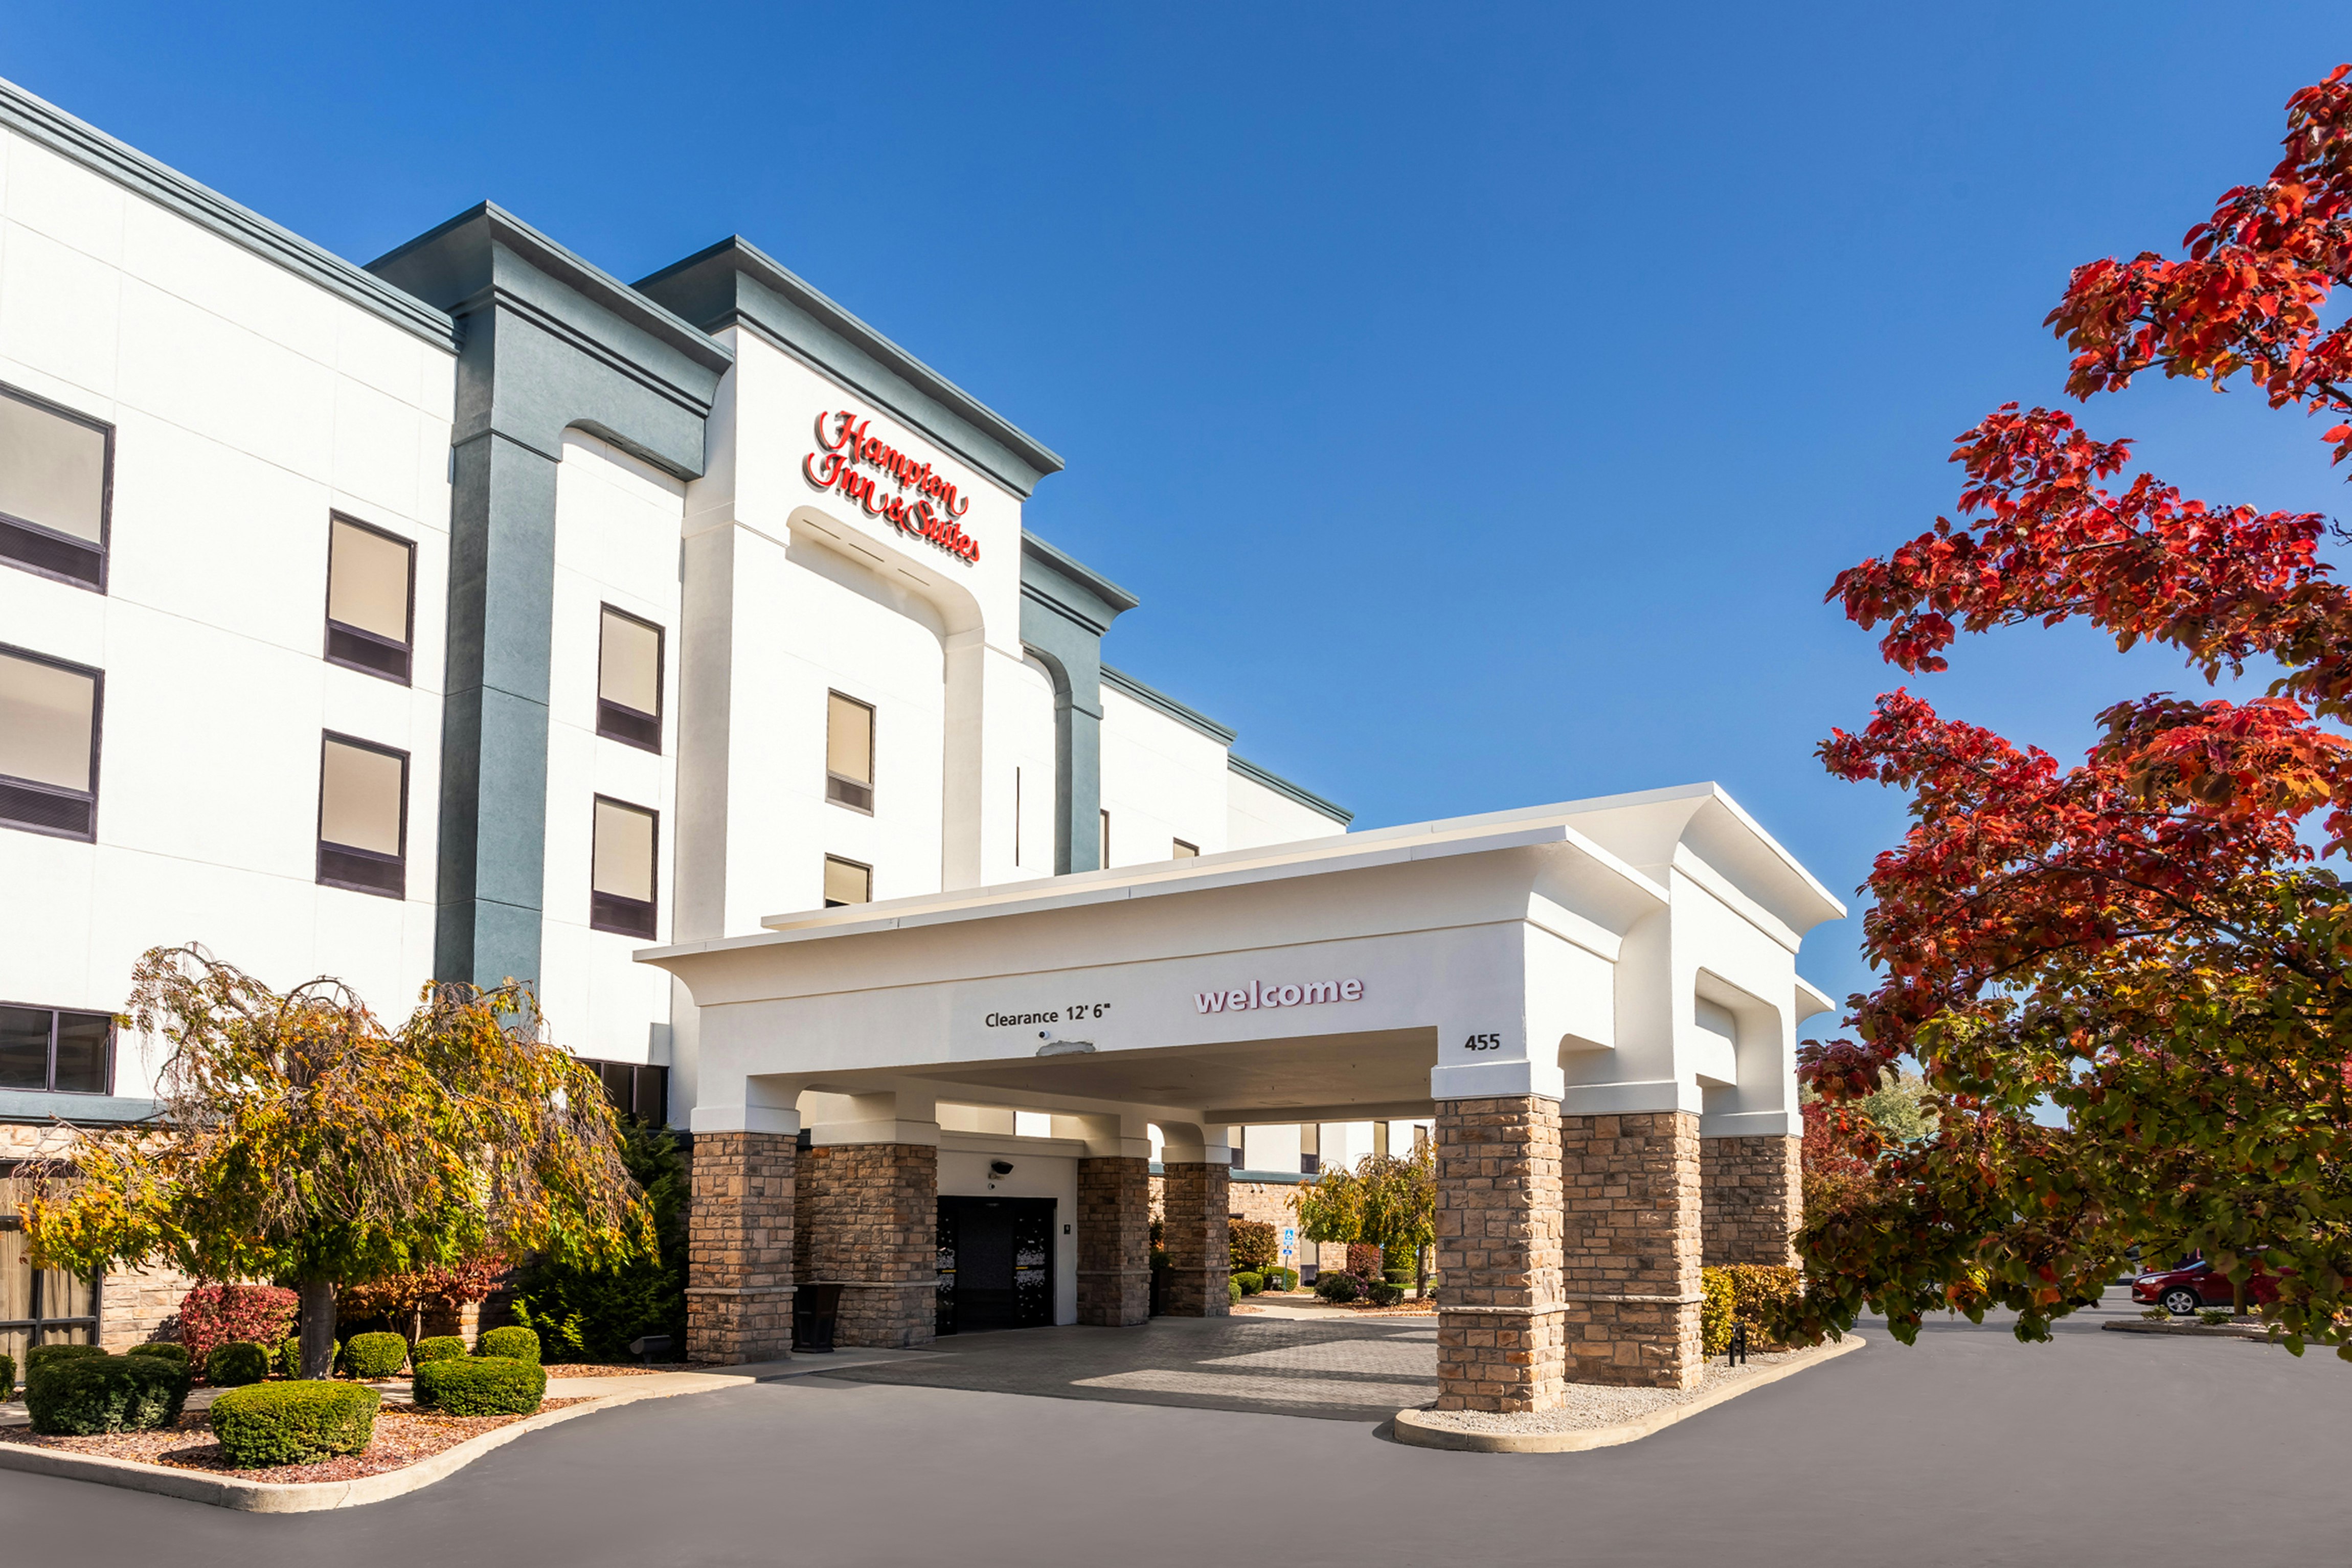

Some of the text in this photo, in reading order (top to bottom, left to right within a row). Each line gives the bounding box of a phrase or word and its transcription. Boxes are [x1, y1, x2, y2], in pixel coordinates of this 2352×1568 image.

[816, 410, 969, 517] Hampton
[803, 452, 980, 563] Inn & Suites
[1193, 978, 1364, 1014] welcome
[985, 1012, 1058, 1027] Clearance
[1066, 1005, 1089, 1020] 12'
[1465, 1033, 1500, 1051] 455
